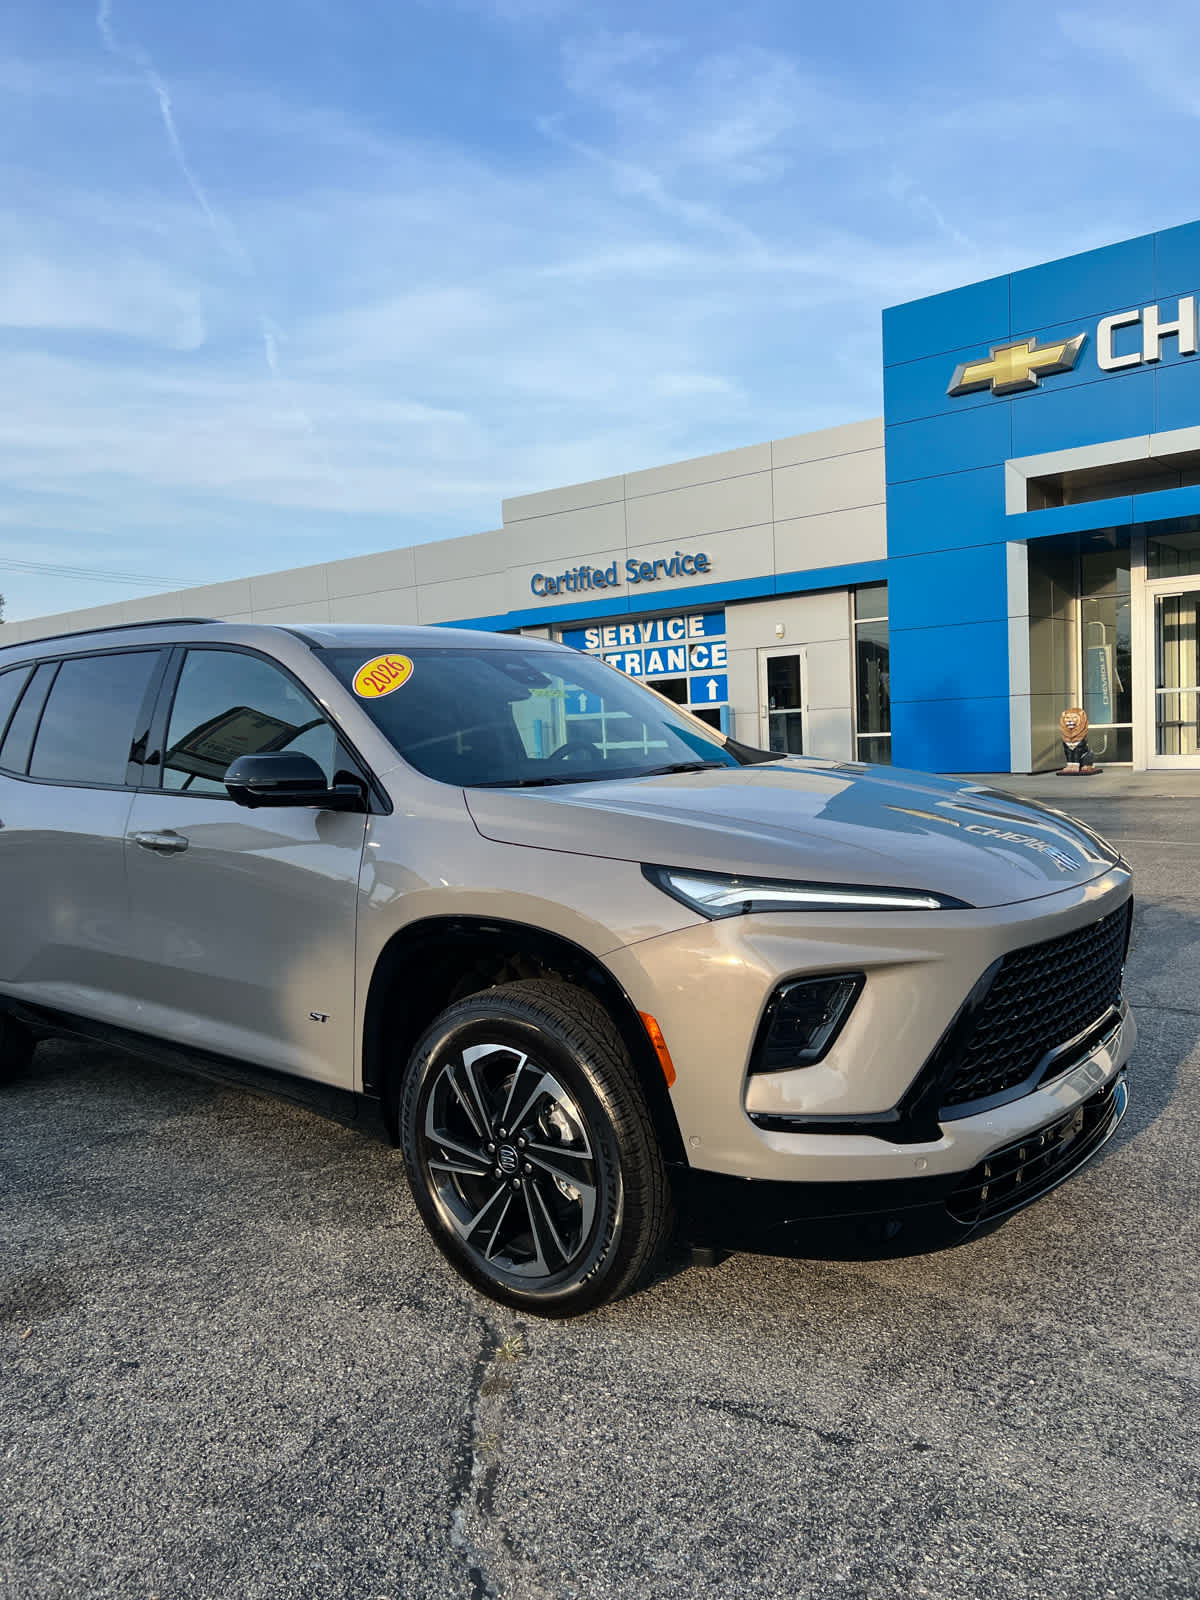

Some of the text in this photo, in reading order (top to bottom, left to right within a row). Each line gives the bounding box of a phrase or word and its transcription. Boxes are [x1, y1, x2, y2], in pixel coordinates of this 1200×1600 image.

[1096, 296, 1198, 373] CH
[531, 551, 709, 597] Certified Service
[585, 615, 705, 649] SERVICE
[362, 656, 406, 693] 2026
[308, 1011, 331, 1023] ST
